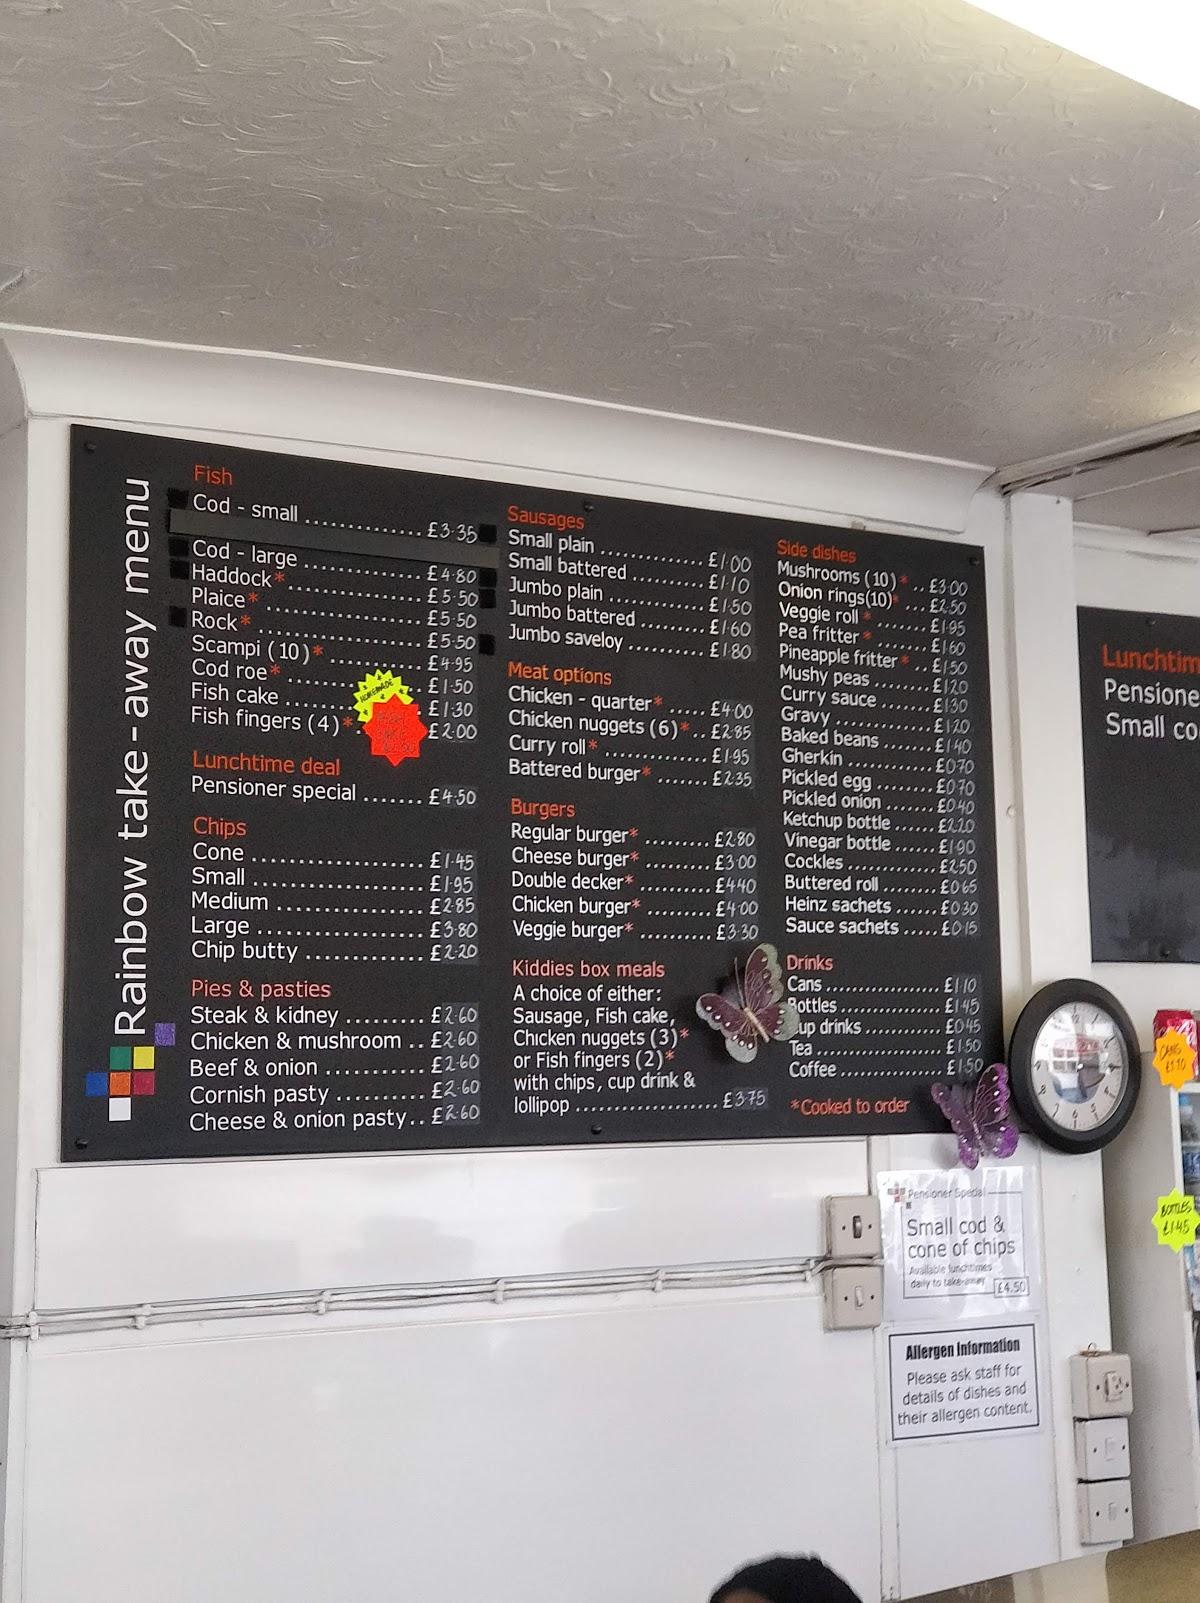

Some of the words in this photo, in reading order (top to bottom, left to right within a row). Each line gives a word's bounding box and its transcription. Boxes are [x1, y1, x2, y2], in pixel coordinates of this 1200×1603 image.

[193, 465, 233, 485] Fish
[193, 494, 230, 514] Cod
[251, 503, 298, 522] small
[507, 505, 584, 531] Sausages
[125, 478, 150, 594] menu
[508, 529, 552, 549] Small
[559, 536, 594, 553] plain
[193, 540, 230, 560] Cod
[251, 546, 298, 567] large
[777, 540, 807, 557] Side
[813, 544, 856, 564] dishes
[558, 556, 627, 580] battered
[777, 560, 860, 584] Mushrooms
[509, 576, 562, 597] Jumbo
[778, 581, 822, 600] Onion
[565, 630, 623, 653] saveloy
[779, 622, 807, 640] Pea
[192, 635, 261, 660] Scampi
[780, 643, 850, 666] Pineapple
[236, 666, 268, 681] roe
[508, 661, 549, 680] Meat
[553, 665, 612, 686] options
[780, 664, 828, 684] Mushy
[834, 672, 870, 687] peas
[192, 683, 230, 701] Fish
[236, 685, 279, 705] cake
[508, 685, 573, 706] Chicken
[831, 691, 877, 708] sauce
[115, 609, 158, 842] take-away
[235, 710, 301, 732] fingers
[579, 715, 645, 737] nuggets
[781, 706, 830, 726] Gravy
[1106, 712, 1164, 738] Small
[1173, 721, 1200, 740] co
[509, 734, 556, 755] Curry
[562, 738, 586, 754] roll
[781, 727, 828, 745] Baked
[834, 732, 879, 748] beans
[193, 750, 295, 774] Lunchtime
[301, 758, 341, 776] deal
[782, 748, 843, 766] Gherkin
[509, 759, 582, 779] Battered
[587, 763, 641, 785] burger
[782, 768, 837, 787] Pickled
[843, 775, 872, 792] egg
[192, 776, 286, 798] Pensioner
[292, 783, 356, 803] special
[511, 798, 575, 820] Burgers
[193, 816, 247, 840] Chips
[783, 811, 842, 830] Ketchup
[847, 814, 891, 830] bottle
[511, 823, 571, 844] Regular
[576, 826, 629, 846] burger
[784, 832, 843, 851] Vinegar
[193, 842, 244, 861] Cone
[784, 853, 843, 870] Cockles
[192, 868, 246, 886] Small
[511, 871, 566, 889] Double
[785, 874, 851, 891] Buttered
[192, 892, 268, 911] Medium
[785, 896, 827, 912] Heinz
[832, 897, 891, 914] sachets
[192, 917, 250, 939] Large
[513, 920, 566, 939] Veggie
[786, 917, 834, 934] Sauce
[114, 856, 150, 1036] Rainbow
[192, 941, 235, 963] Chip
[242, 941, 298, 963] butty
[512, 960, 574, 977] Kiddies
[581, 960, 610, 976] box
[617, 961, 665, 977] meals
[787, 954, 833, 971] Drinks
[192, 979, 232, 998] Pies
[261, 979, 332, 1002] pasties
[514, 986, 525, 1002] A
[530, 985, 582, 1002] choice
[587, 985, 602, 1001] of
[607, 985, 662, 1002] either:
[787, 975, 822, 992] Cans
[191, 1006, 246, 1025] Steak
[276, 1005, 338, 1029] kidney
[513, 1008, 590, 1027] Sausage,
[633, 1007, 675, 1026] cake,
[795, 1022, 816, 1038] up
[820, 1019, 862, 1035] drinks
[191, 1031, 269, 1050] Chicken
[299, 1031, 402, 1049] mushroom
[789, 1040, 812, 1056] Tea
[190, 1058, 237, 1077] Beef
[266, 1058, 318, 1076] onion
[514, 1053, 531, 1069] or
[789, 1061, 837, 1077] Coffee
[514, 1074, 550, 1090] with
[555, 1073, 602, 1093] chips,
[608, 1072, 635, 1092] cup
[640, 1071, 679, 1088] drink
[190, 1084, 268, 1104] Cornish
[274, 1085, 330, 1106] pasty
[514, 1096, 570, 1116] lollipop
[856, 1099, 870, 1114] to
[875, 1098, 910, 1113] order
[189, 1112, 265, 1132] Cheese
[908, 1189, 952, 1199] Pensioner
[907, 1217, 952, 1236] Small
[959, 1216, 986, 1234] cod
[994, 1215, 1005, 1233] &
[908, 1243, 946, 1258] cone
[952, 1238, 969, 1256] of
[974, 1238, 1015, 1258] chips
[933, 1279, 941, 1288] to
[906, 1344, 954, 1360] Allergen
[957, 1337, 1020, 1356] Information
[907, 1372, 947, 1385] Please
[950, 1368, 971, 1382] ask
[975, 1364, 1002, 1380] staff
[1004, 1363, 1023, 1377] for
[902, 1390, 944, 1406] details
[947, 1388, 960, 1401] of
[964, 1386, 1001, 1400] dishes
[1004, 1382, 1026, 1396] and
[898, 1412, 927, 1425] their
[931, 1408, 980, 1423] allergen
[983, 1401, 1032, 1417] content.
